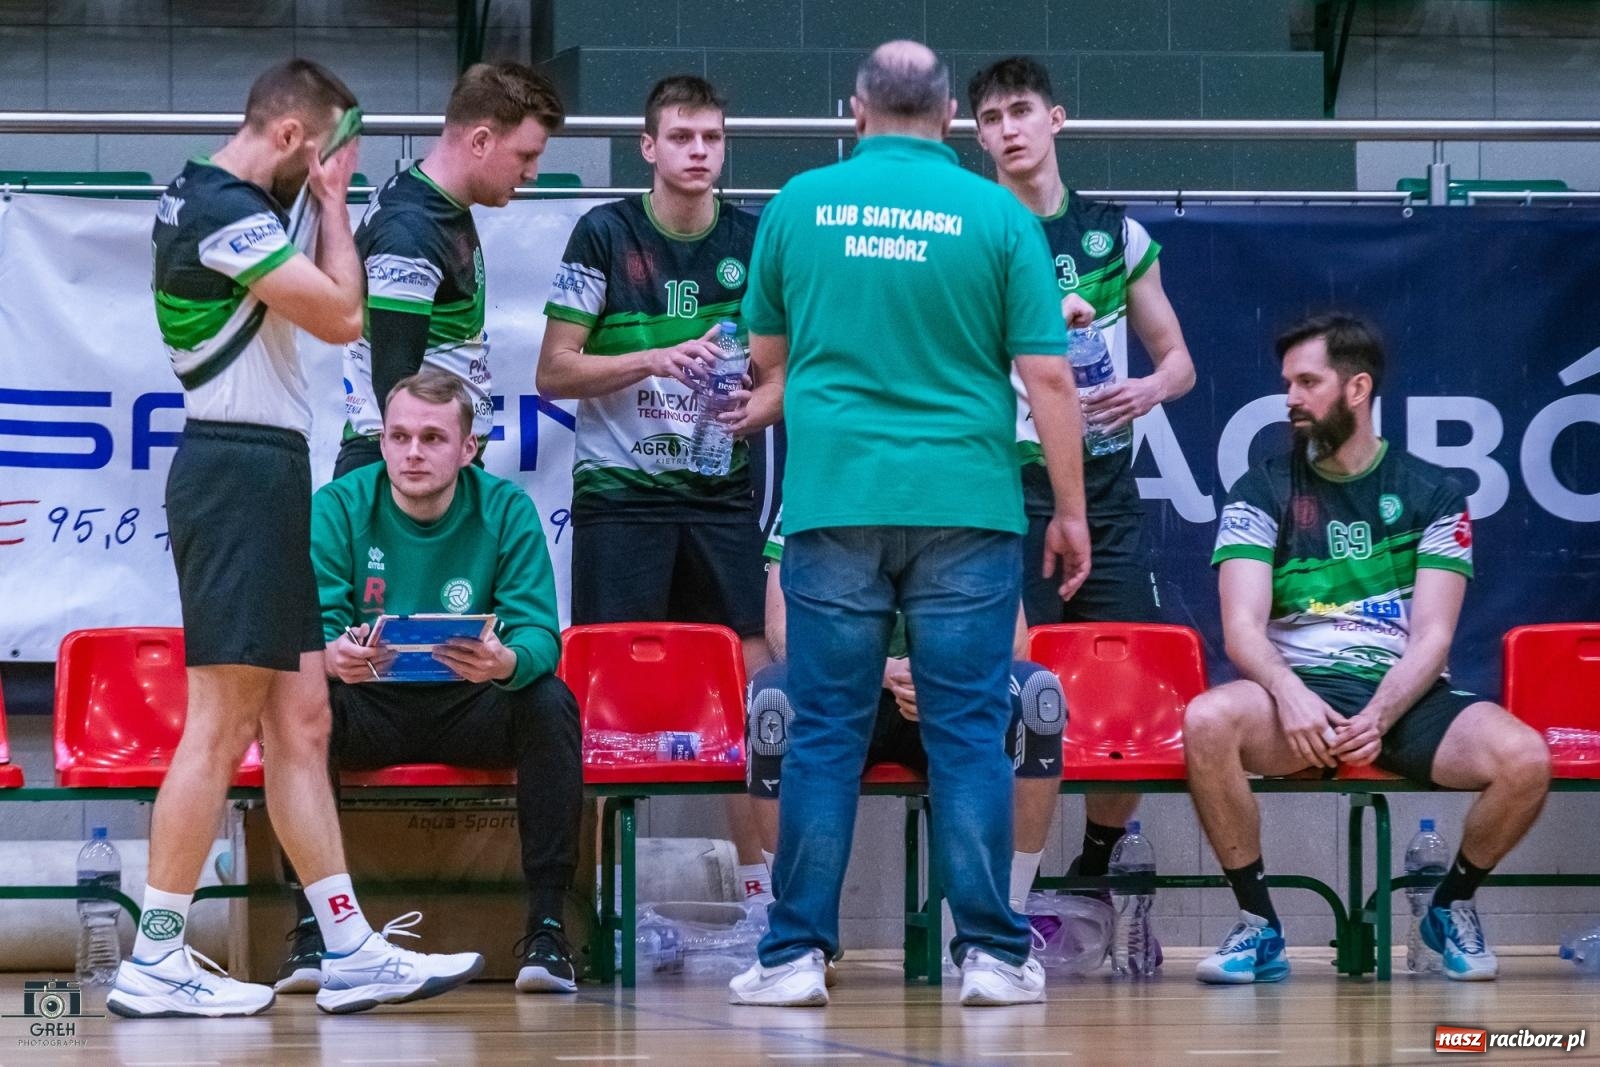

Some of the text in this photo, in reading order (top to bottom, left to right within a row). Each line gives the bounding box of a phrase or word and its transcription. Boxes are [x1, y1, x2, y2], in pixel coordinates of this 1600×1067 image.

[816, 204, 963, 236] KLUB SIATKARSKI
[844, 234, 929, 263] RACIBÓRZ
[664, 279, 699, 319] 16
[48, 506, 140, 549] 95,8
[1327, 520, 1373, 560] 69
[363, 576, 386, 604] R
[408, 814, 517, 832] Aqua-Sport
[328, 893, 355, 916] R
